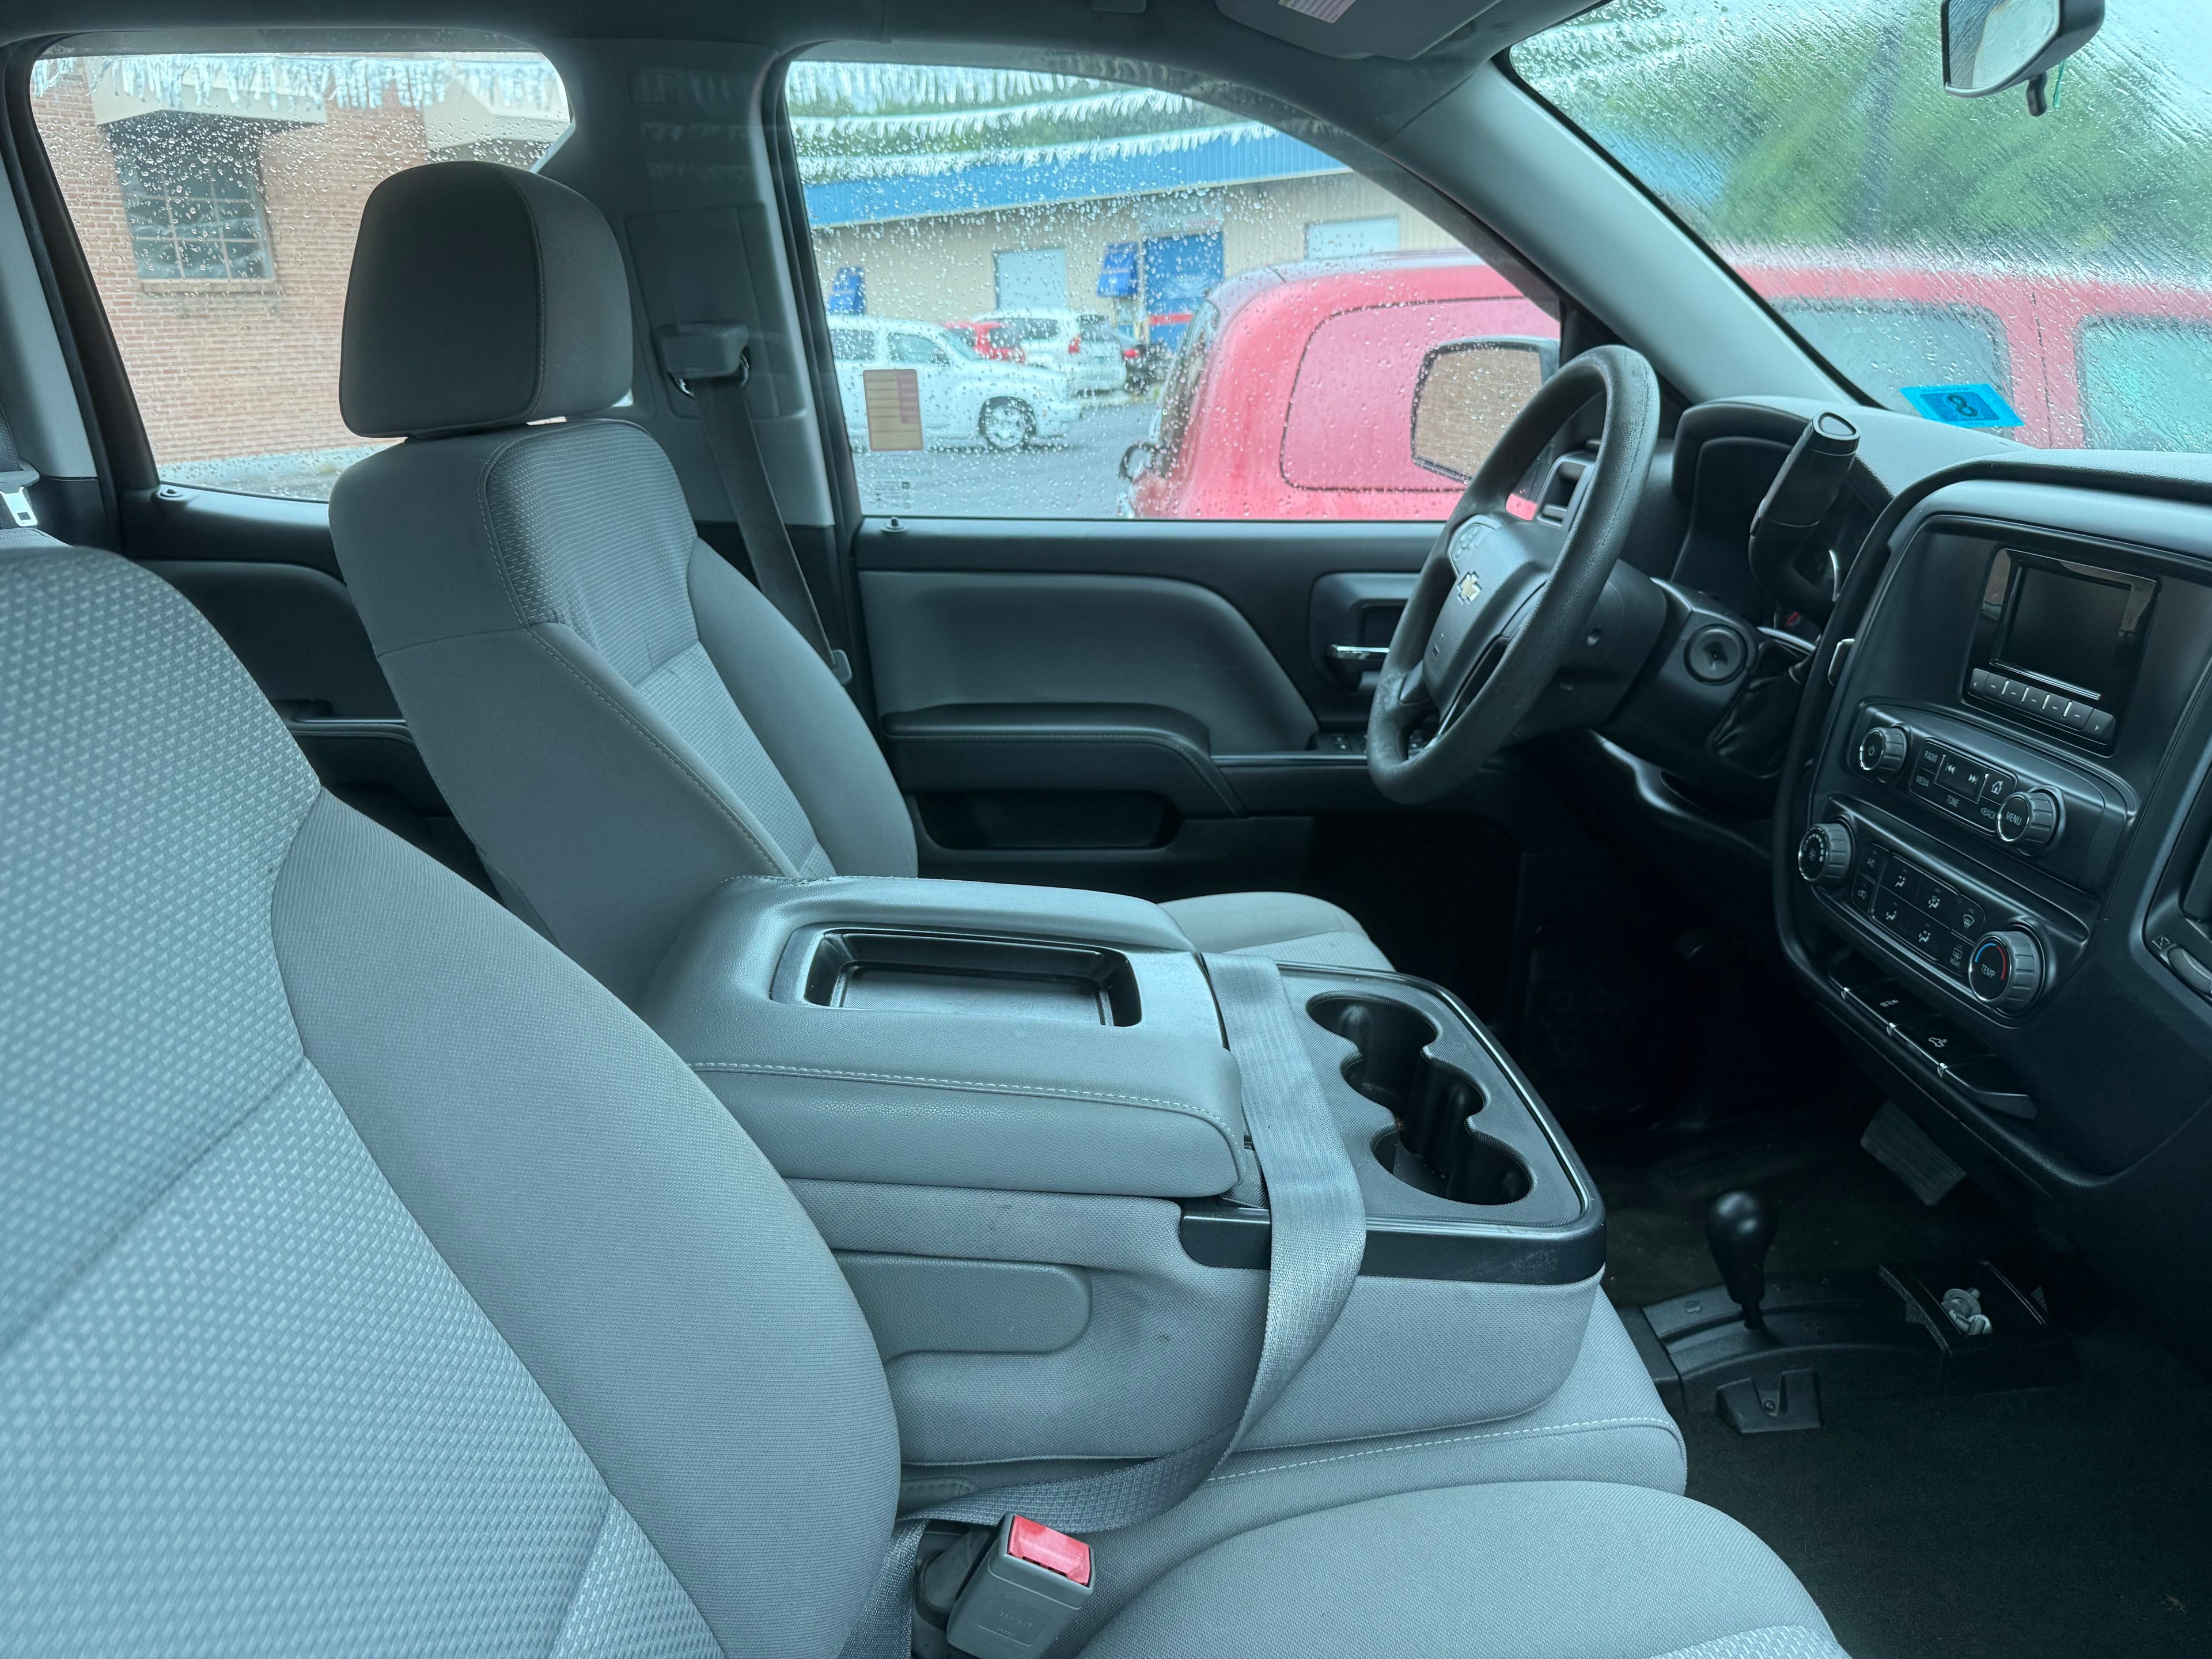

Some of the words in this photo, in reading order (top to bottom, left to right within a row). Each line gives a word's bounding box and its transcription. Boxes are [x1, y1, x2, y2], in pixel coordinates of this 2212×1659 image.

[1947, 394, 1978, 417] 8
[1923, 751, 1938, 763] RADIO
[1946, 795, 1959, 808] TONE
[1983, 808, 1997, 820] BACK
[2005, 811, 2022, 825] MENU
[1982, 963, 1995, 978] TEMP
